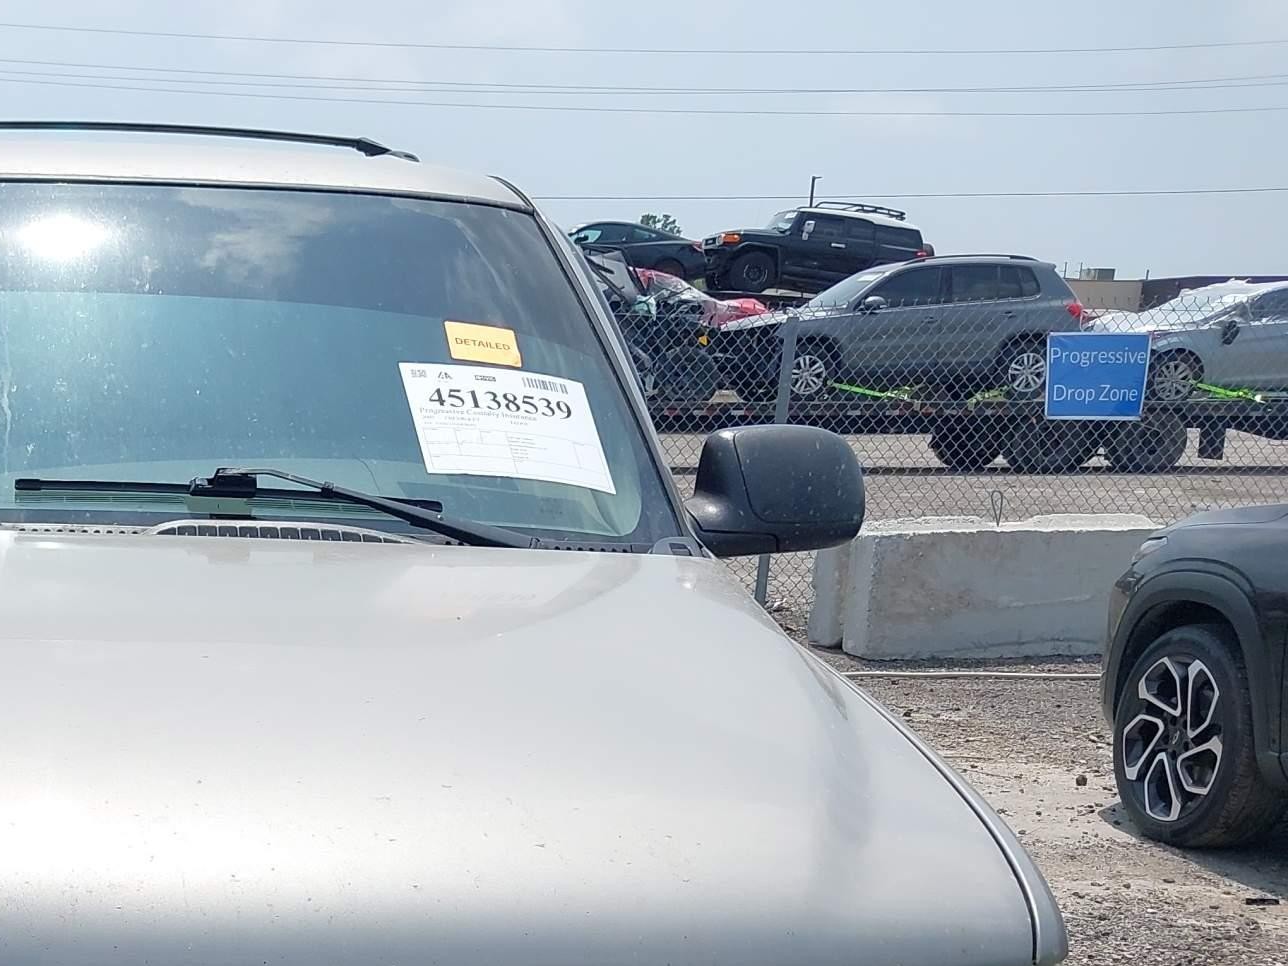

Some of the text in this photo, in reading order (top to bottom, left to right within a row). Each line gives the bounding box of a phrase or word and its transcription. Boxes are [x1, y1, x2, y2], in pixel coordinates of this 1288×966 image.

[455, 337, 511, 351] DETAILED
[1050, 346, 1146, 367] Progressive
[429, 387, 573, 420] 45138539
[1053, 384, 1138, 404] Drop Zone
